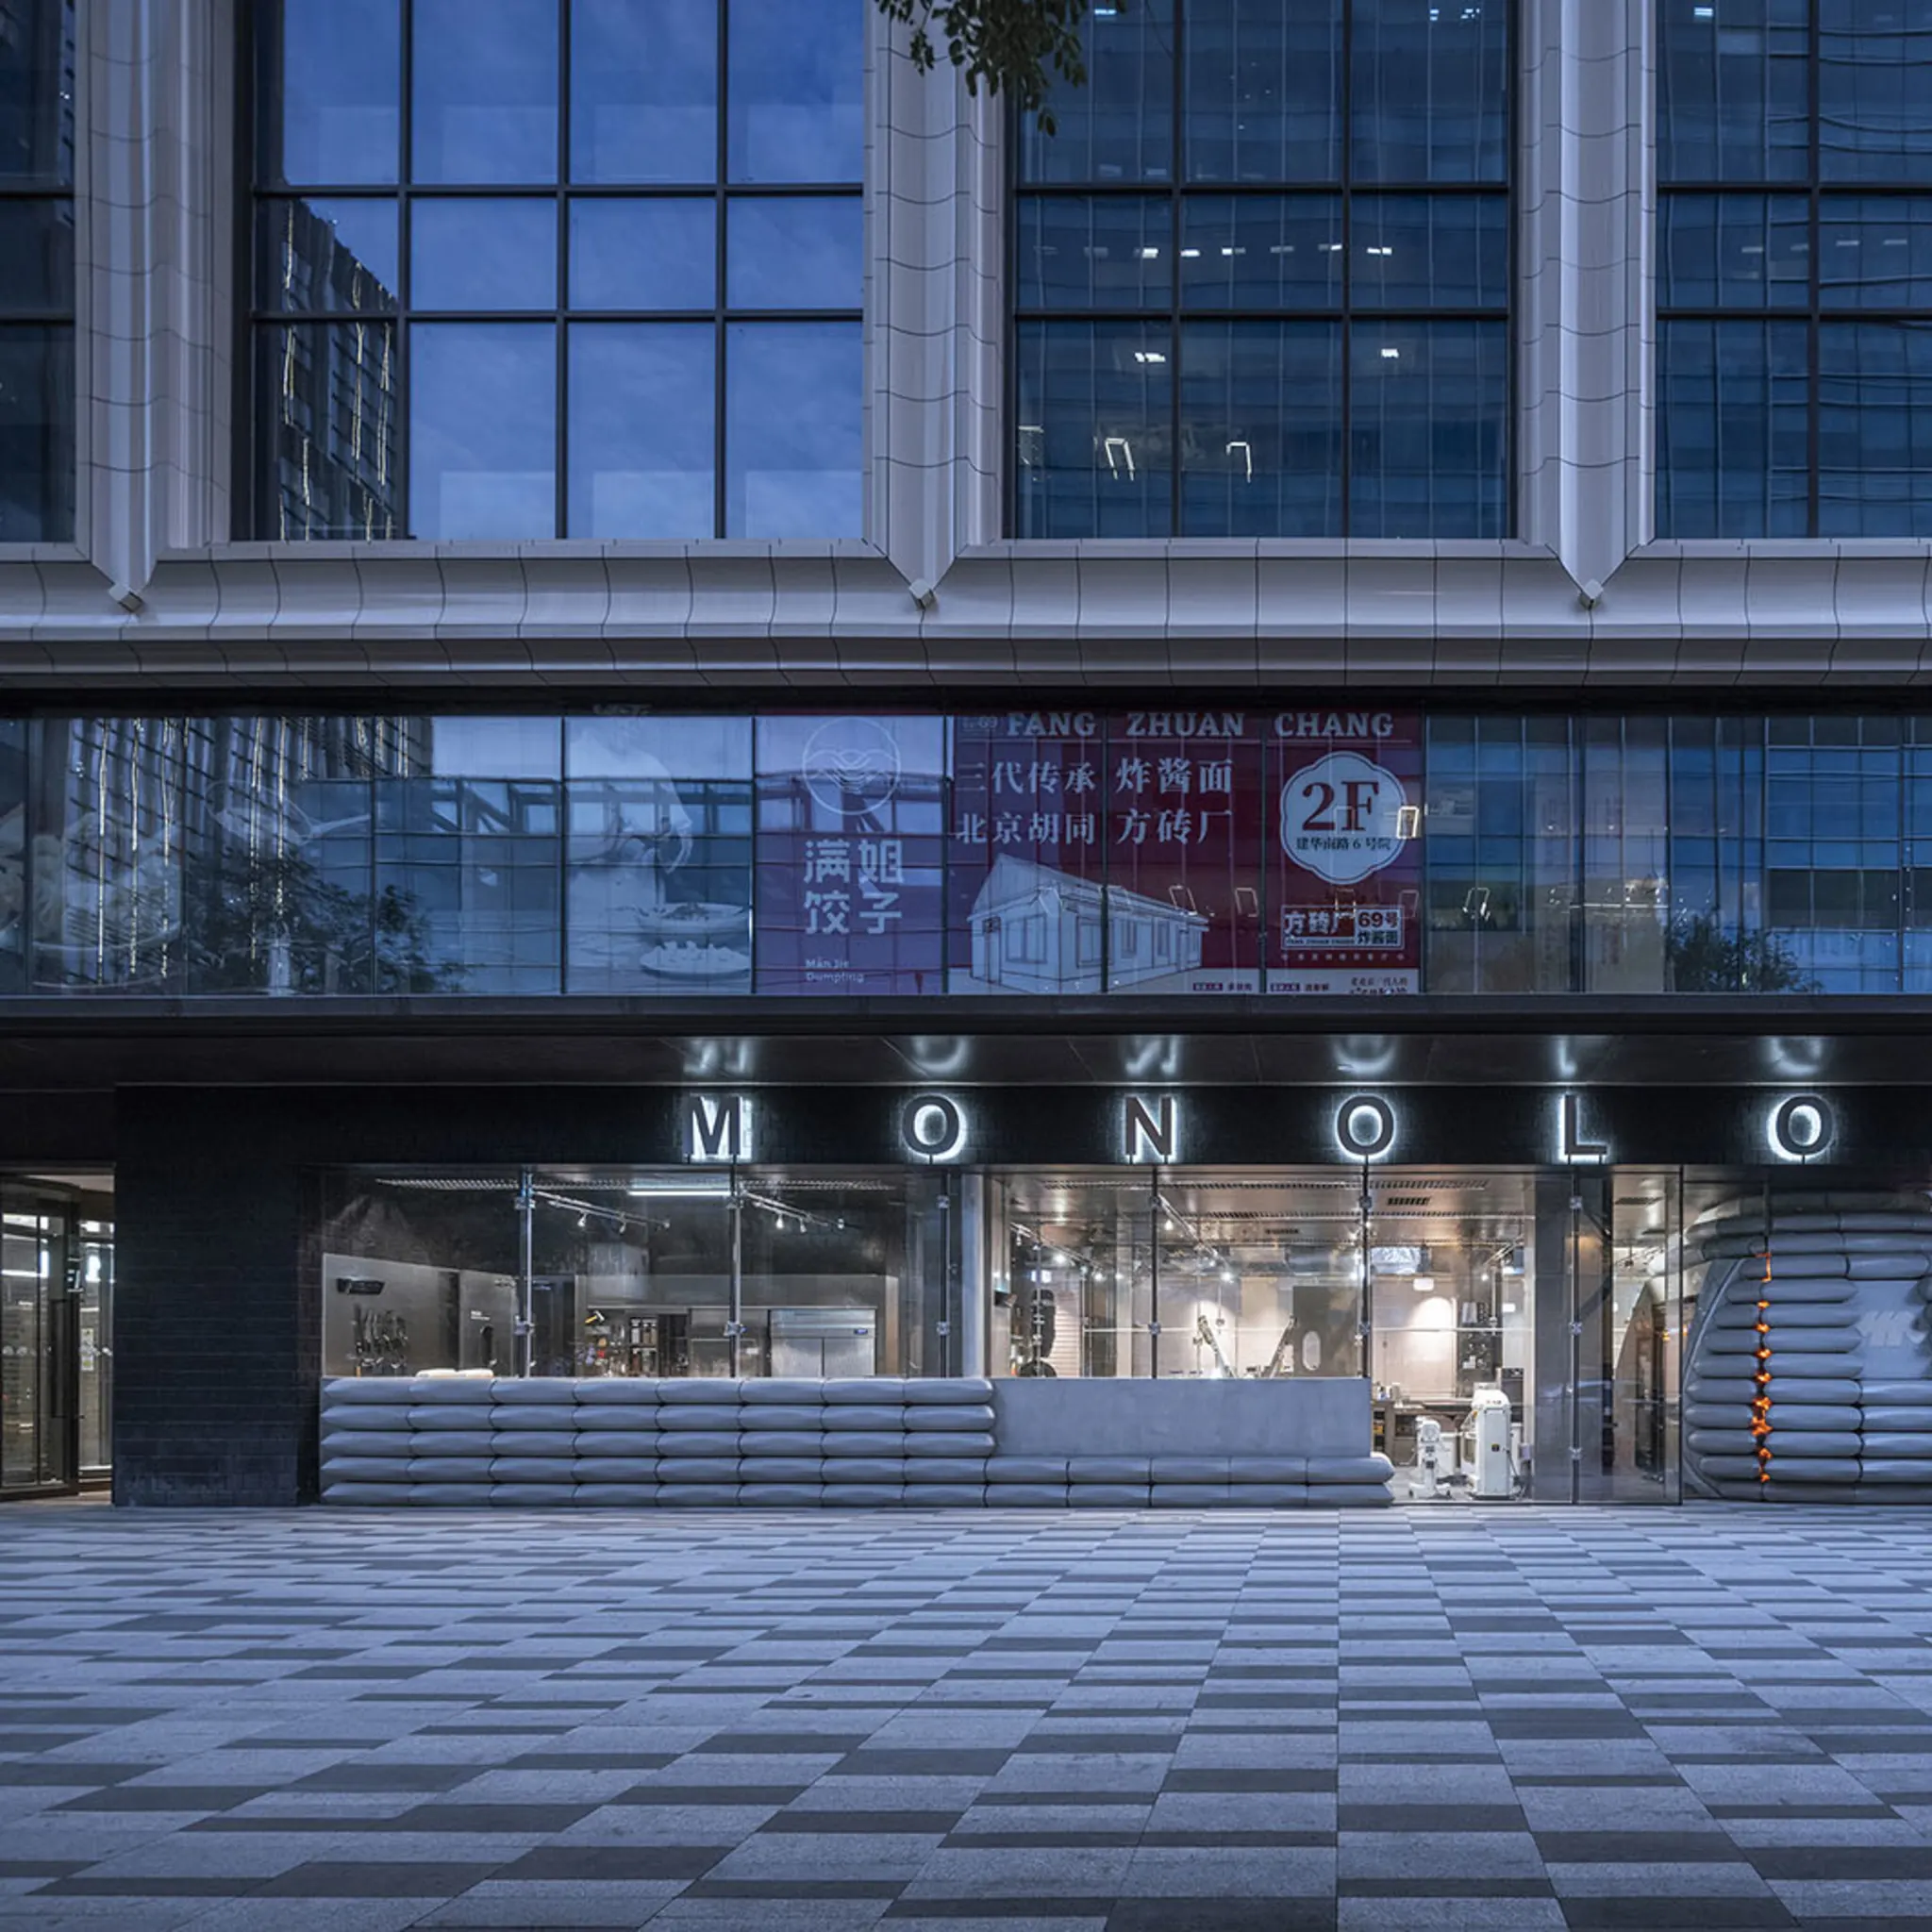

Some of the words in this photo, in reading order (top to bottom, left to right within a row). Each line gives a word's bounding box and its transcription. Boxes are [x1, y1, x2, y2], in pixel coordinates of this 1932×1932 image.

[1007, 712, 1097, 737] FANG
[1125, 712, 1245, 737] ZHUAN
[1274, 712, 1394, 738] CHANG
[956, 759, 1097, 794] 三代传承
[1115, 757, 1234, 794] 炸酱面
[954, 812, 1097, 844] 北京胡同
[1115, 808, 1234, 845] 方砖厂
[1301, 781, 1379, 832] 2F
[803, 839, 903, 883] 满姐
[803, 889, 903, 935] 饺子
